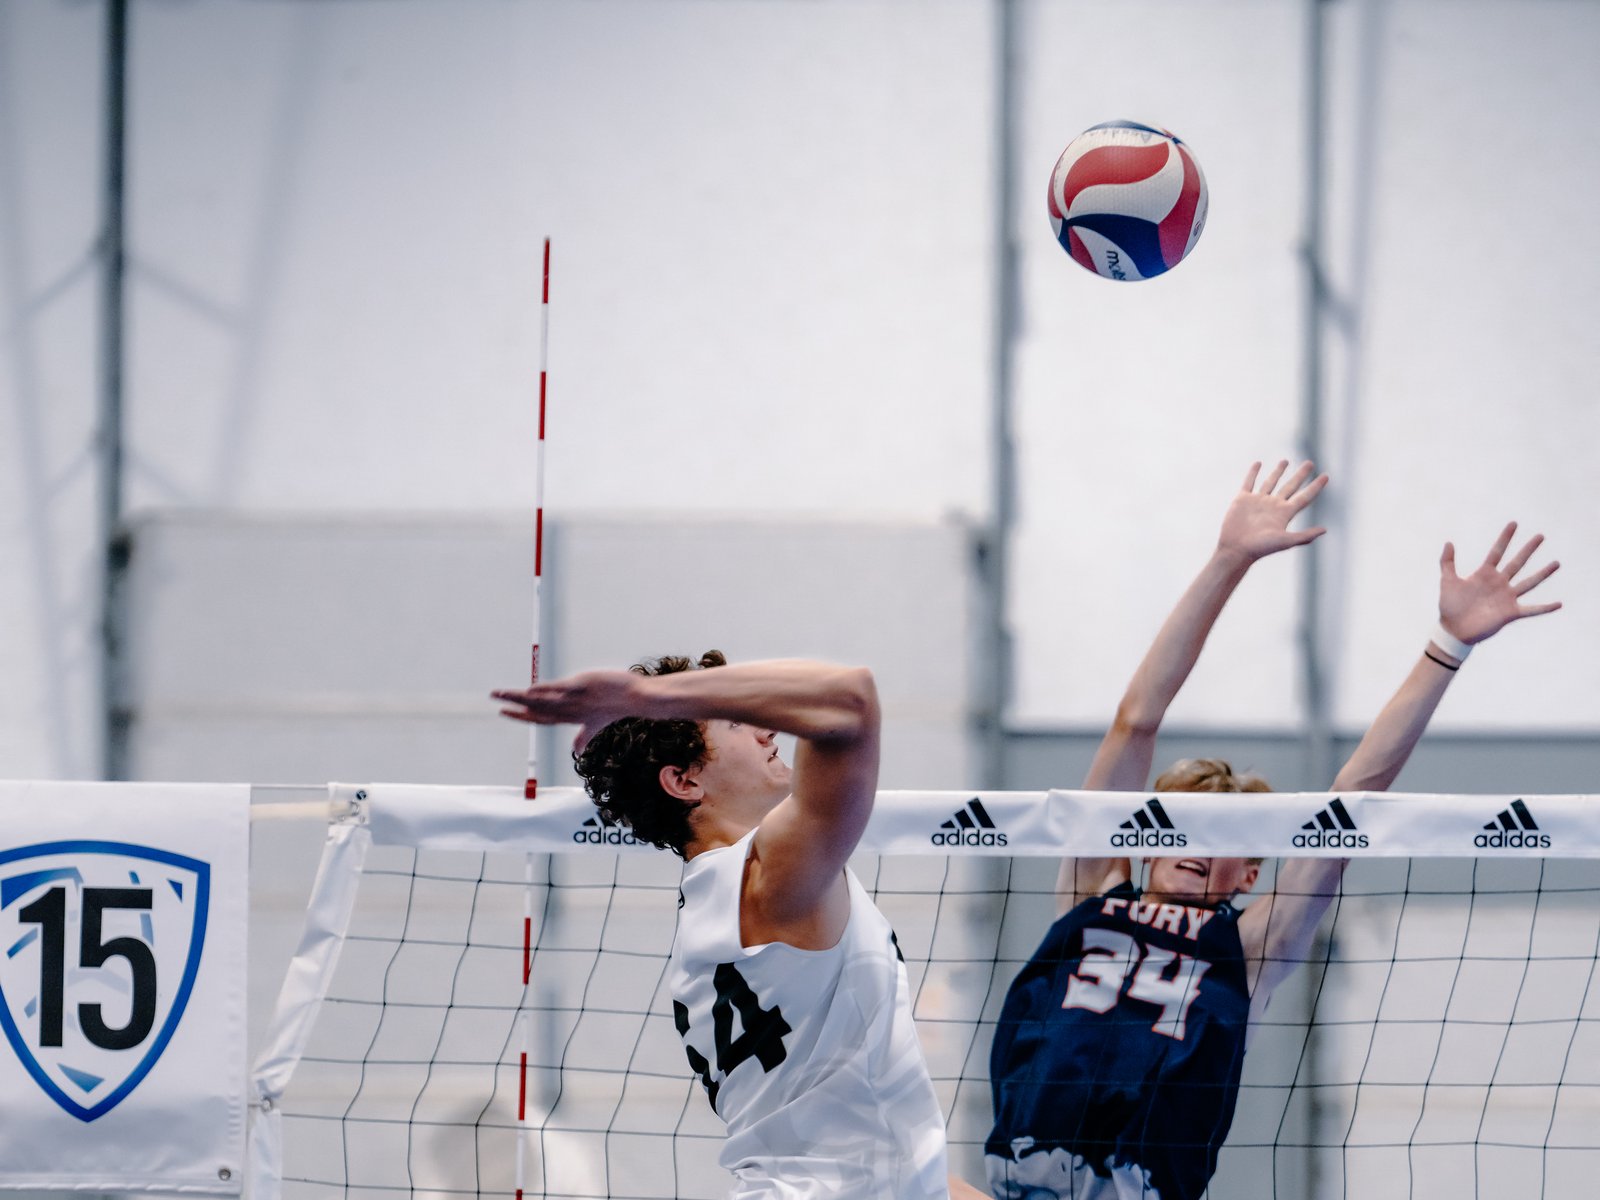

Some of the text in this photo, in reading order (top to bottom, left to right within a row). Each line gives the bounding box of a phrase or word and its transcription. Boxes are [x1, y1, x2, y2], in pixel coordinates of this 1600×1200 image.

[573, 827, 650, 845] adida
[931, 827, 1008, 847] adidas
[1110, 828, 1188, 847] adidas
[1292, 828, 1369, 848] adidas
[1473, 829, 1551, 848] adidas
[1101, 897, 1216, 941] FURY
[18, 886, 157, 1051] 15
[1061, 927, 1213, 1041] 34
